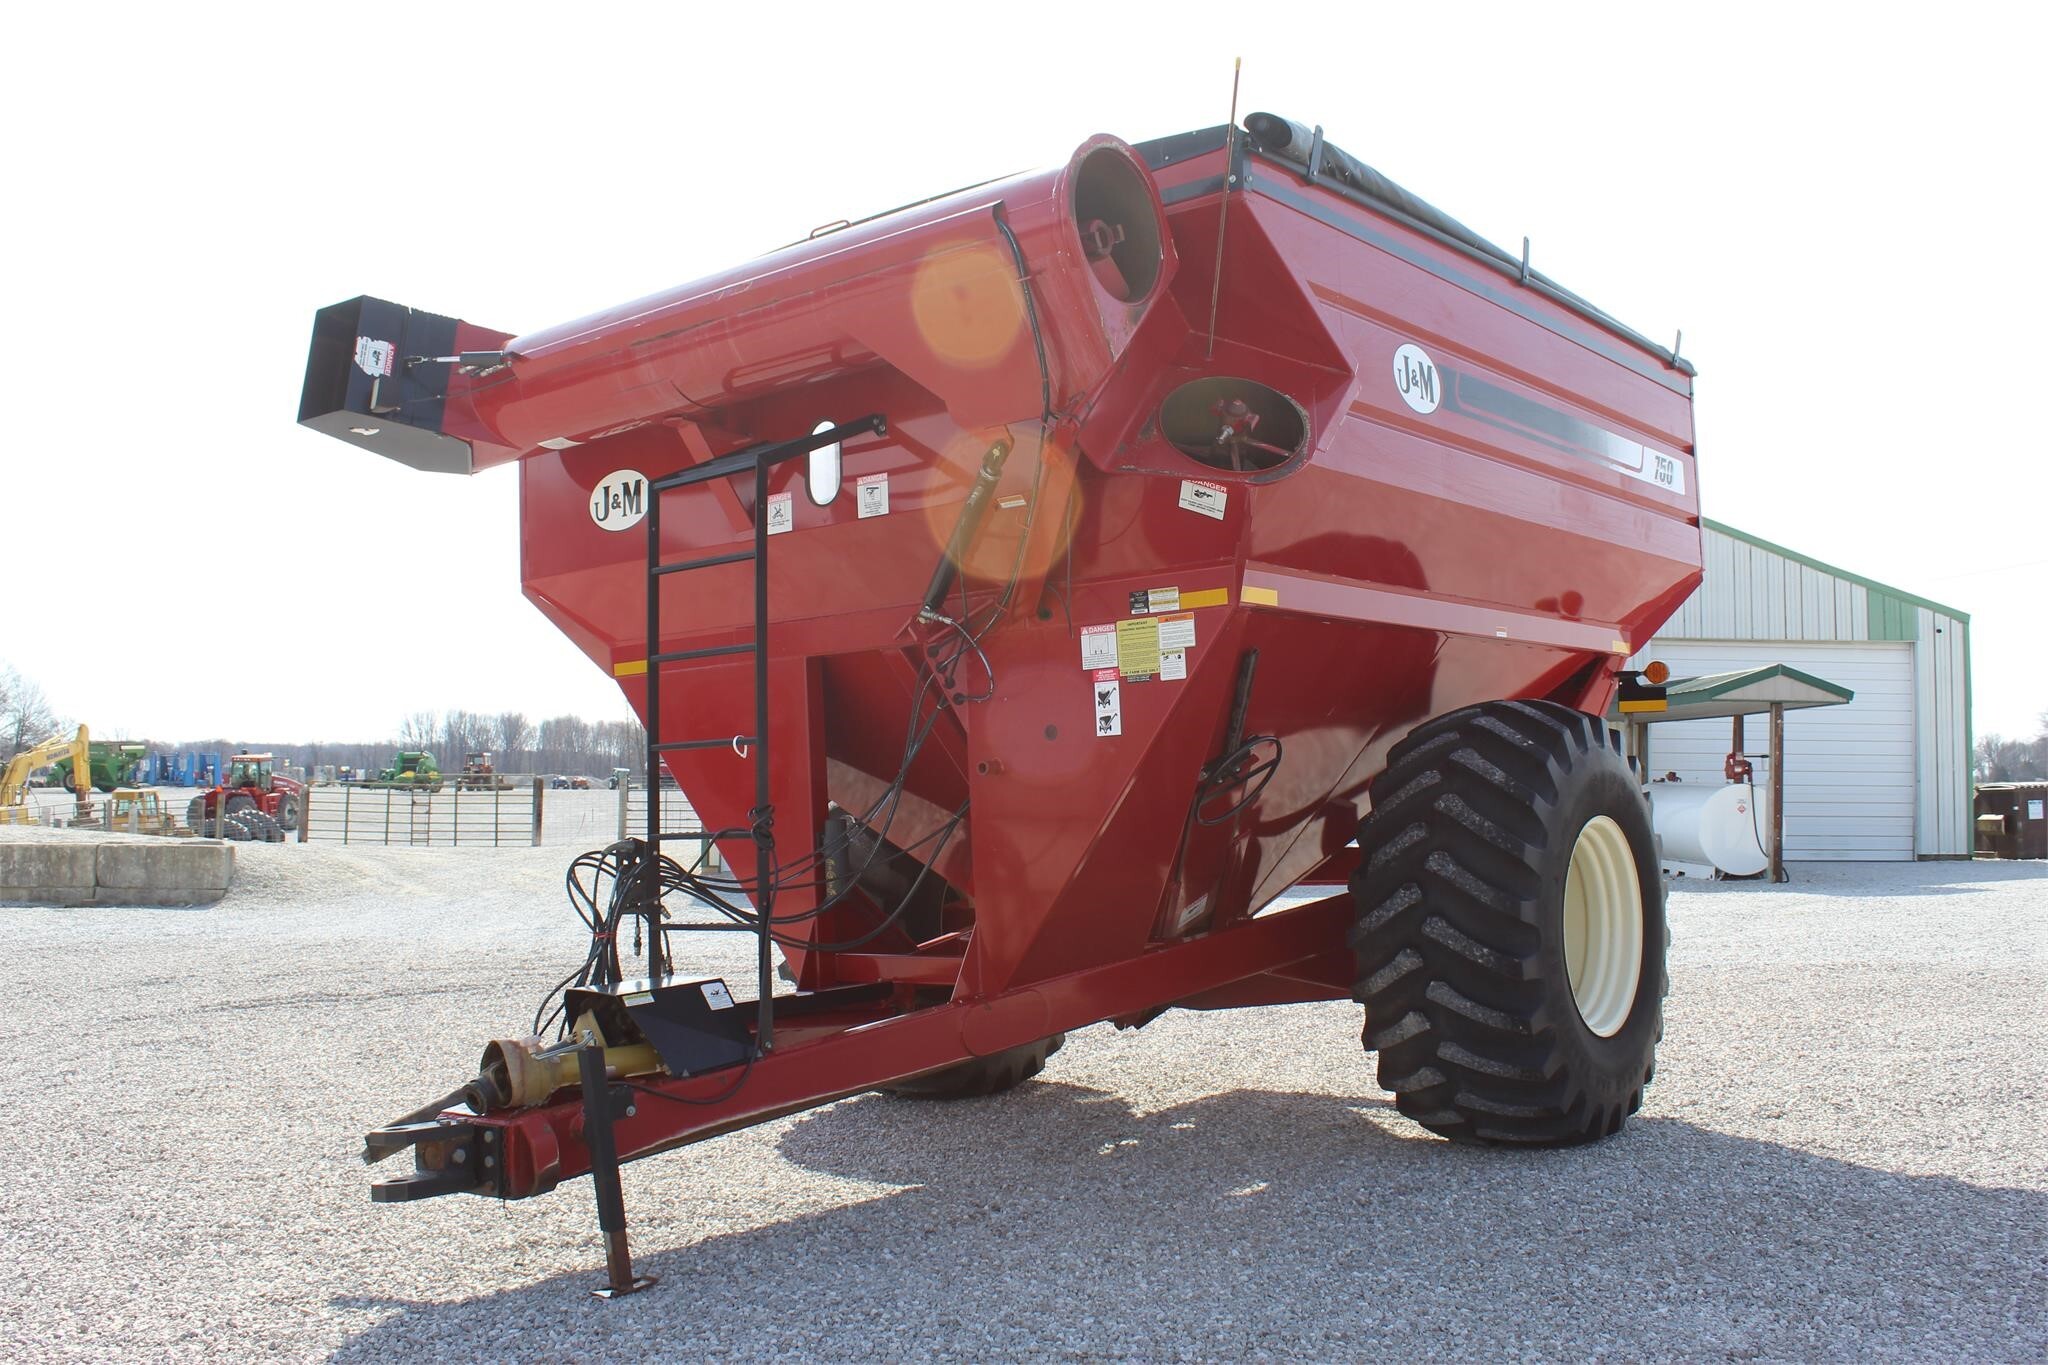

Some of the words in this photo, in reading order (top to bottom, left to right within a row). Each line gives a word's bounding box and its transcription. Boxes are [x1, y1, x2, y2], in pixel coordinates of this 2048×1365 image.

[1397, 354, 1435, 404] J&M
[1654, 455, 1674, 485] 750
[594, 478, 642, 522] J&M
[1088, 624, 1116, 634] DANGER
